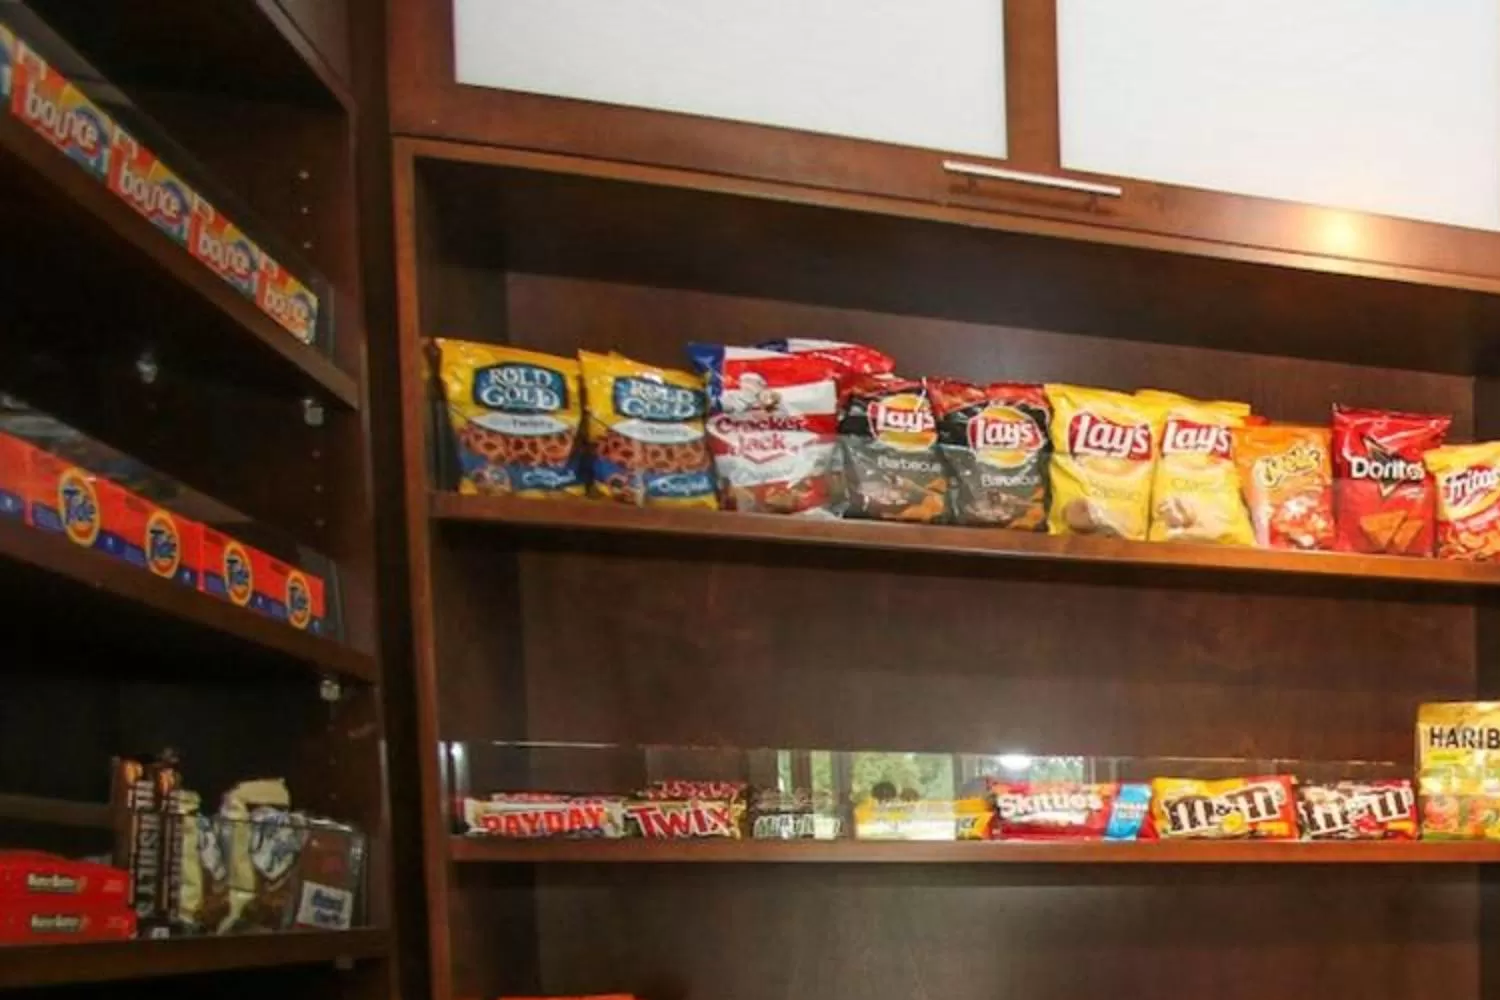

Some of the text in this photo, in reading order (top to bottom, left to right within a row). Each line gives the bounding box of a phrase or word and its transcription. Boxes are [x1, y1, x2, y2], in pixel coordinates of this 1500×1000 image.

[489, 366, 554, 391] ROLD
[481, 384, 561, 411] GOLD
[714, 414, 804, 434] Cracker
[733, 432, 787, 455] Jack
[1351, 456, 1426, 482] Doritos
[481, 804, 606, 834] PAYDAY
